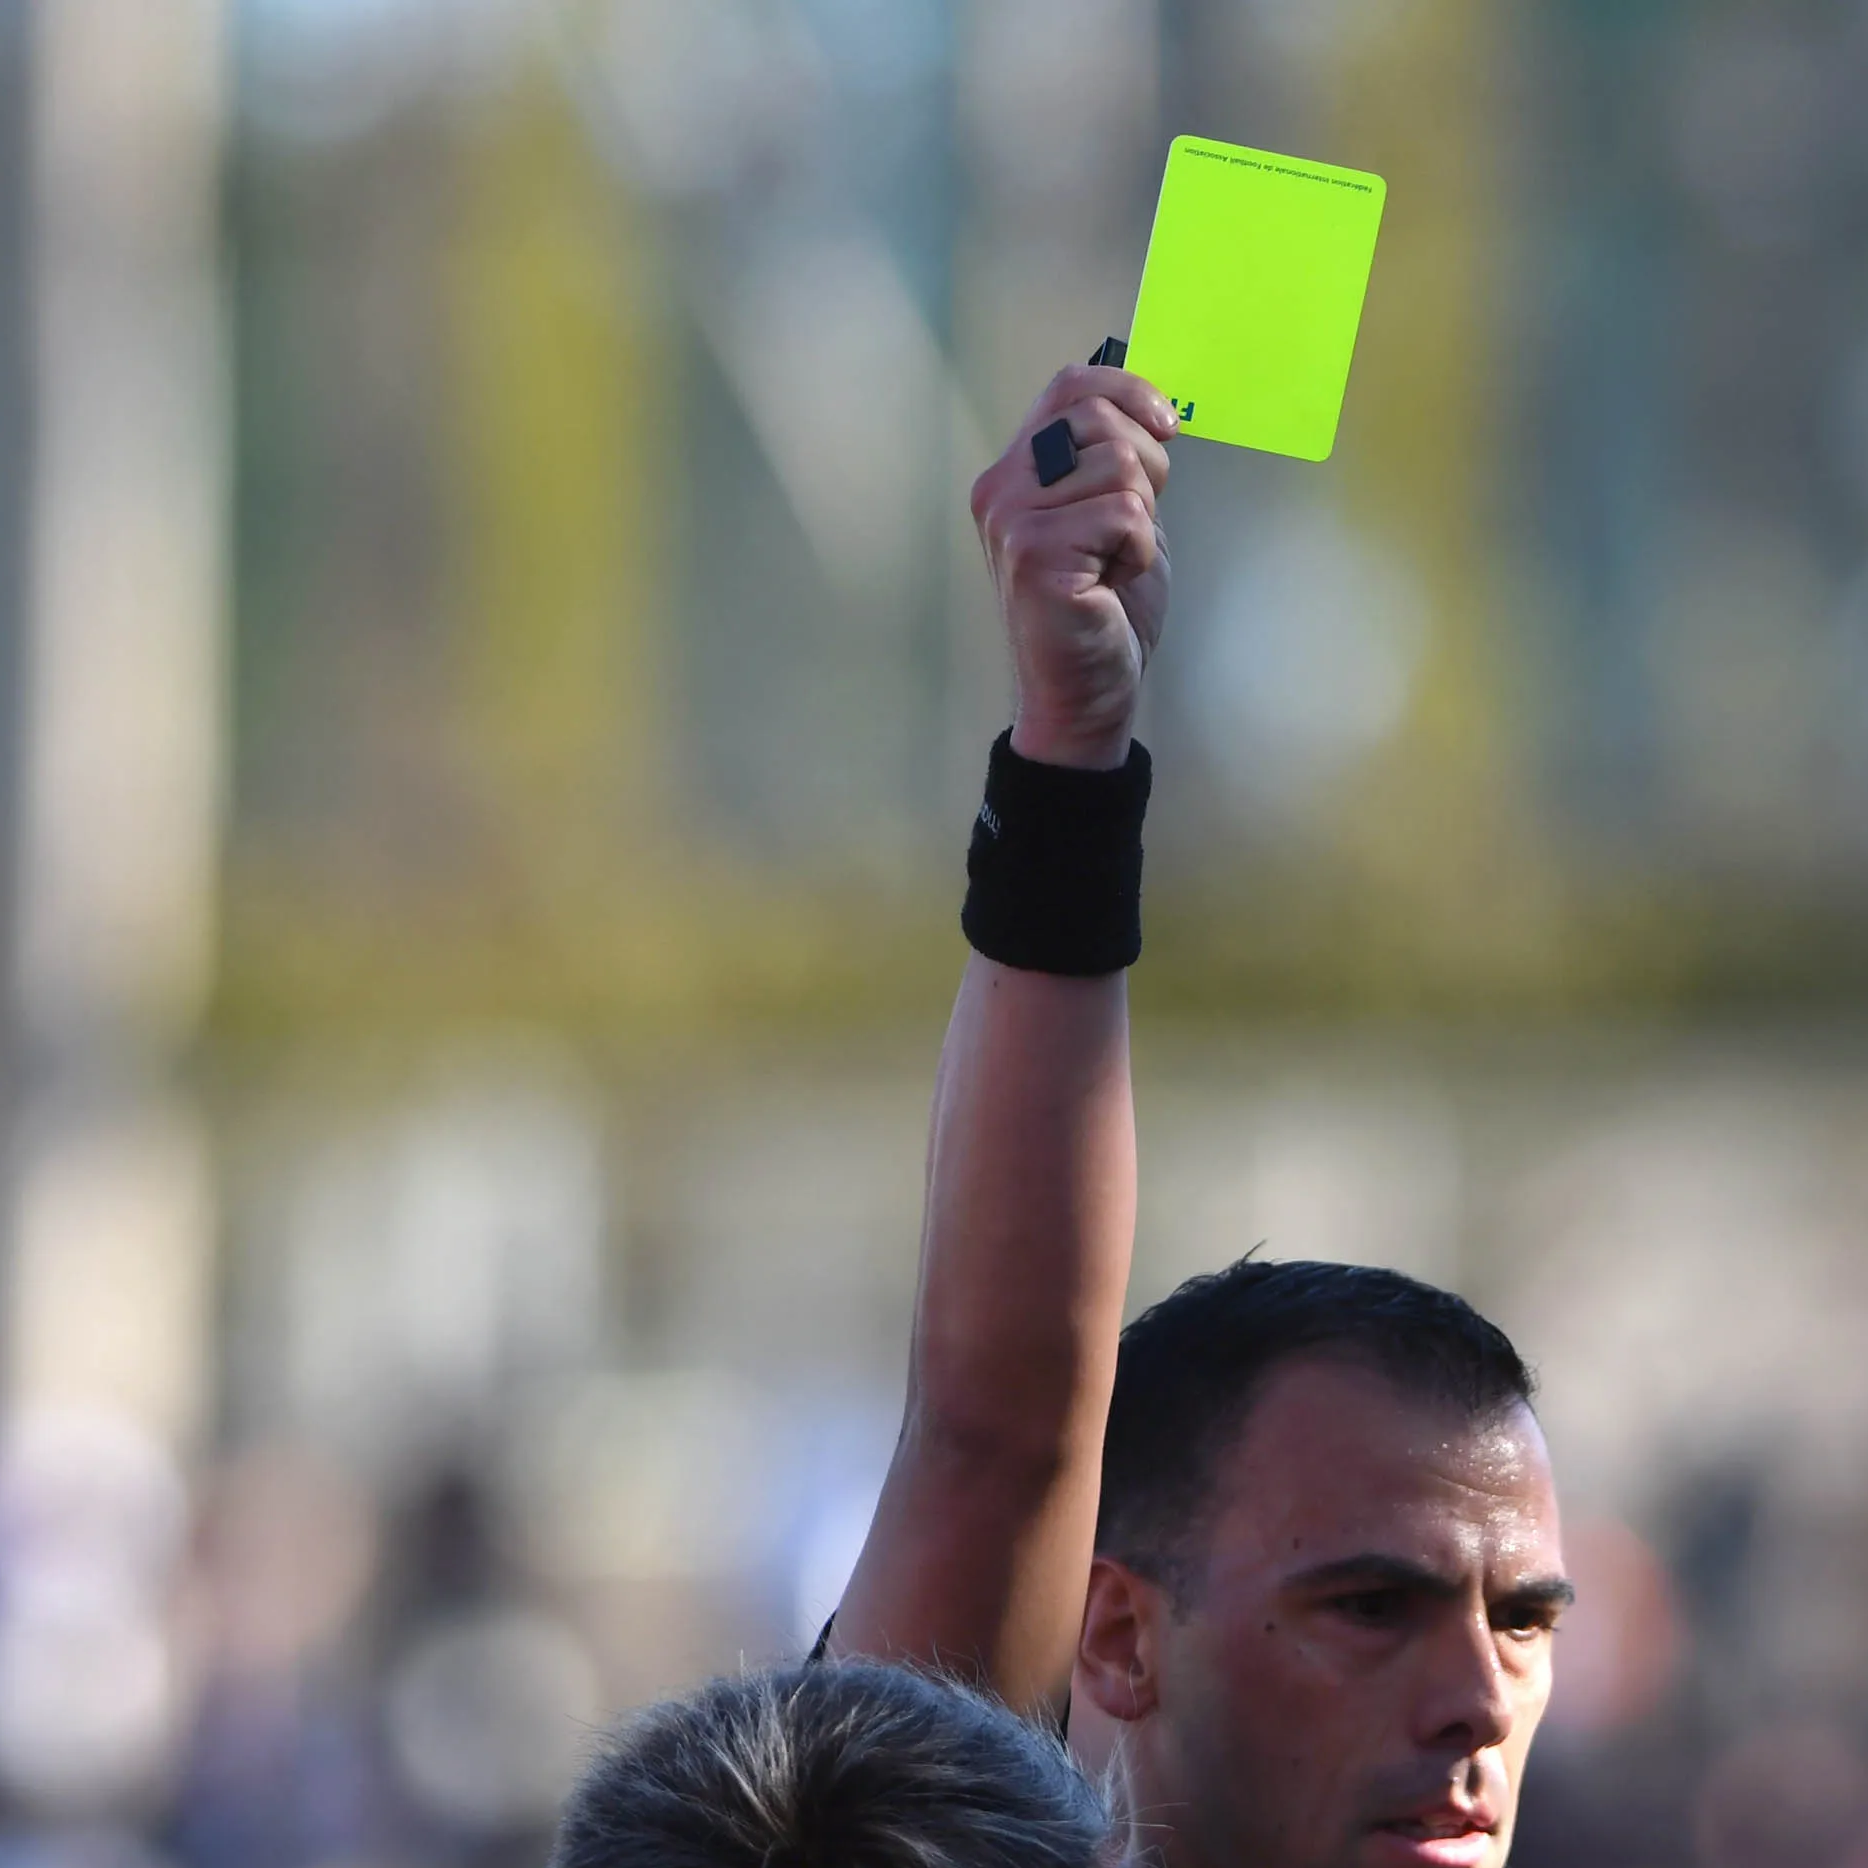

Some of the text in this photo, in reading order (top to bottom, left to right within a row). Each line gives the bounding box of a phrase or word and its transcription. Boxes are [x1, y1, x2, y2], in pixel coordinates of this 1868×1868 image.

[1184, 147, 1229, 162] Association
[1230, 157, 1262, 171] Football
[1263, 163, 1275, 172] de
